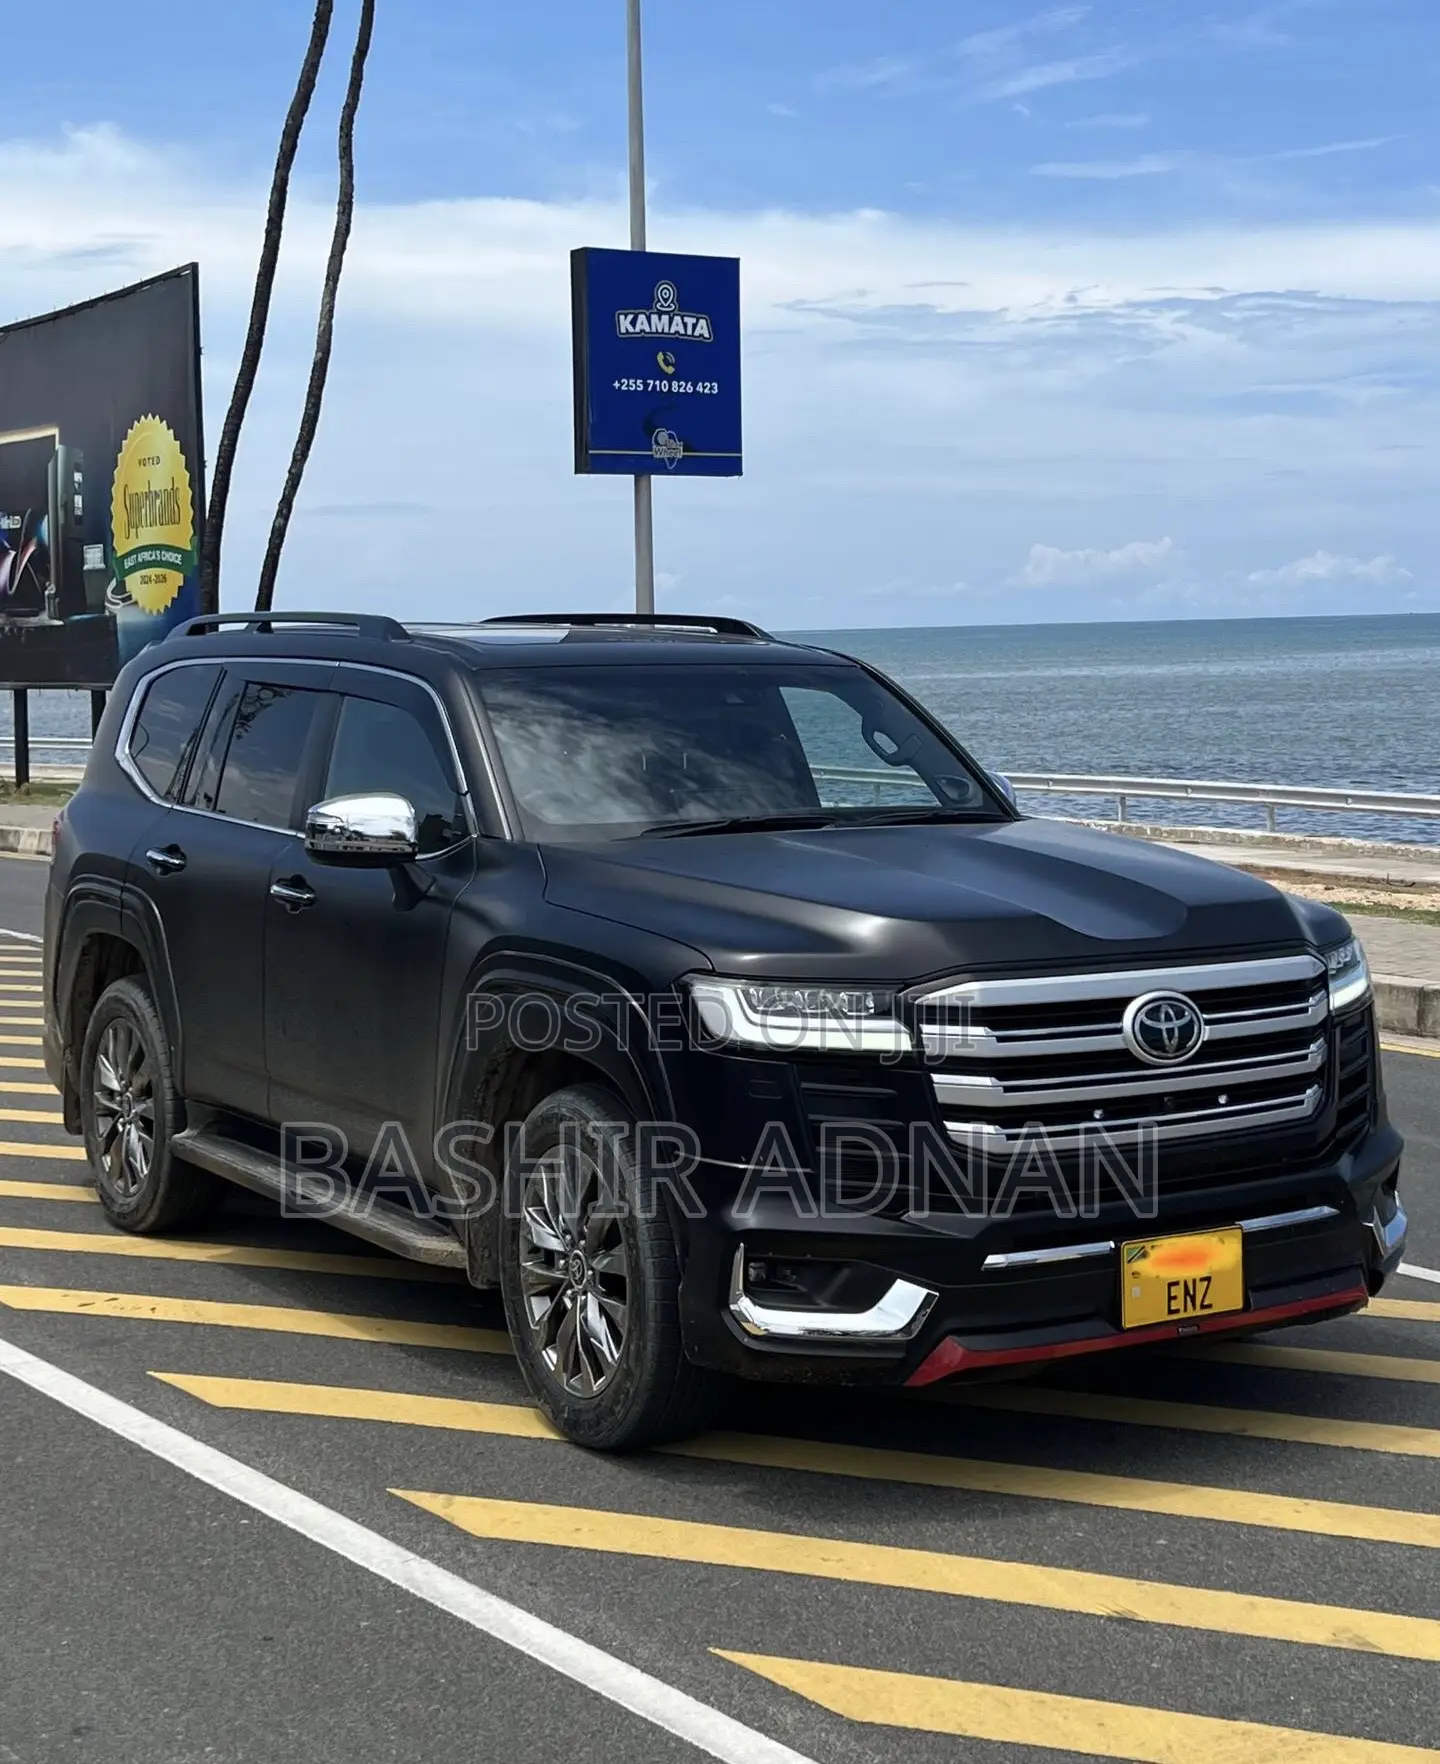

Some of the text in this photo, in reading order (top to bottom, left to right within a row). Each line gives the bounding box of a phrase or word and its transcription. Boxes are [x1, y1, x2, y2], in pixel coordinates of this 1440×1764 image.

[619, 314, 711, 338] KAMATA
[613, 379, 718, 394] +255 710 826 423
[138, 456, 161, 467] VOTED
[124, 477, 181, 540] Superbrands
[124, 554, 137, 569] EAST
[161, 550, 183, 565] CHOICE
[1167, 1276, 1213, 1315] ENZ
